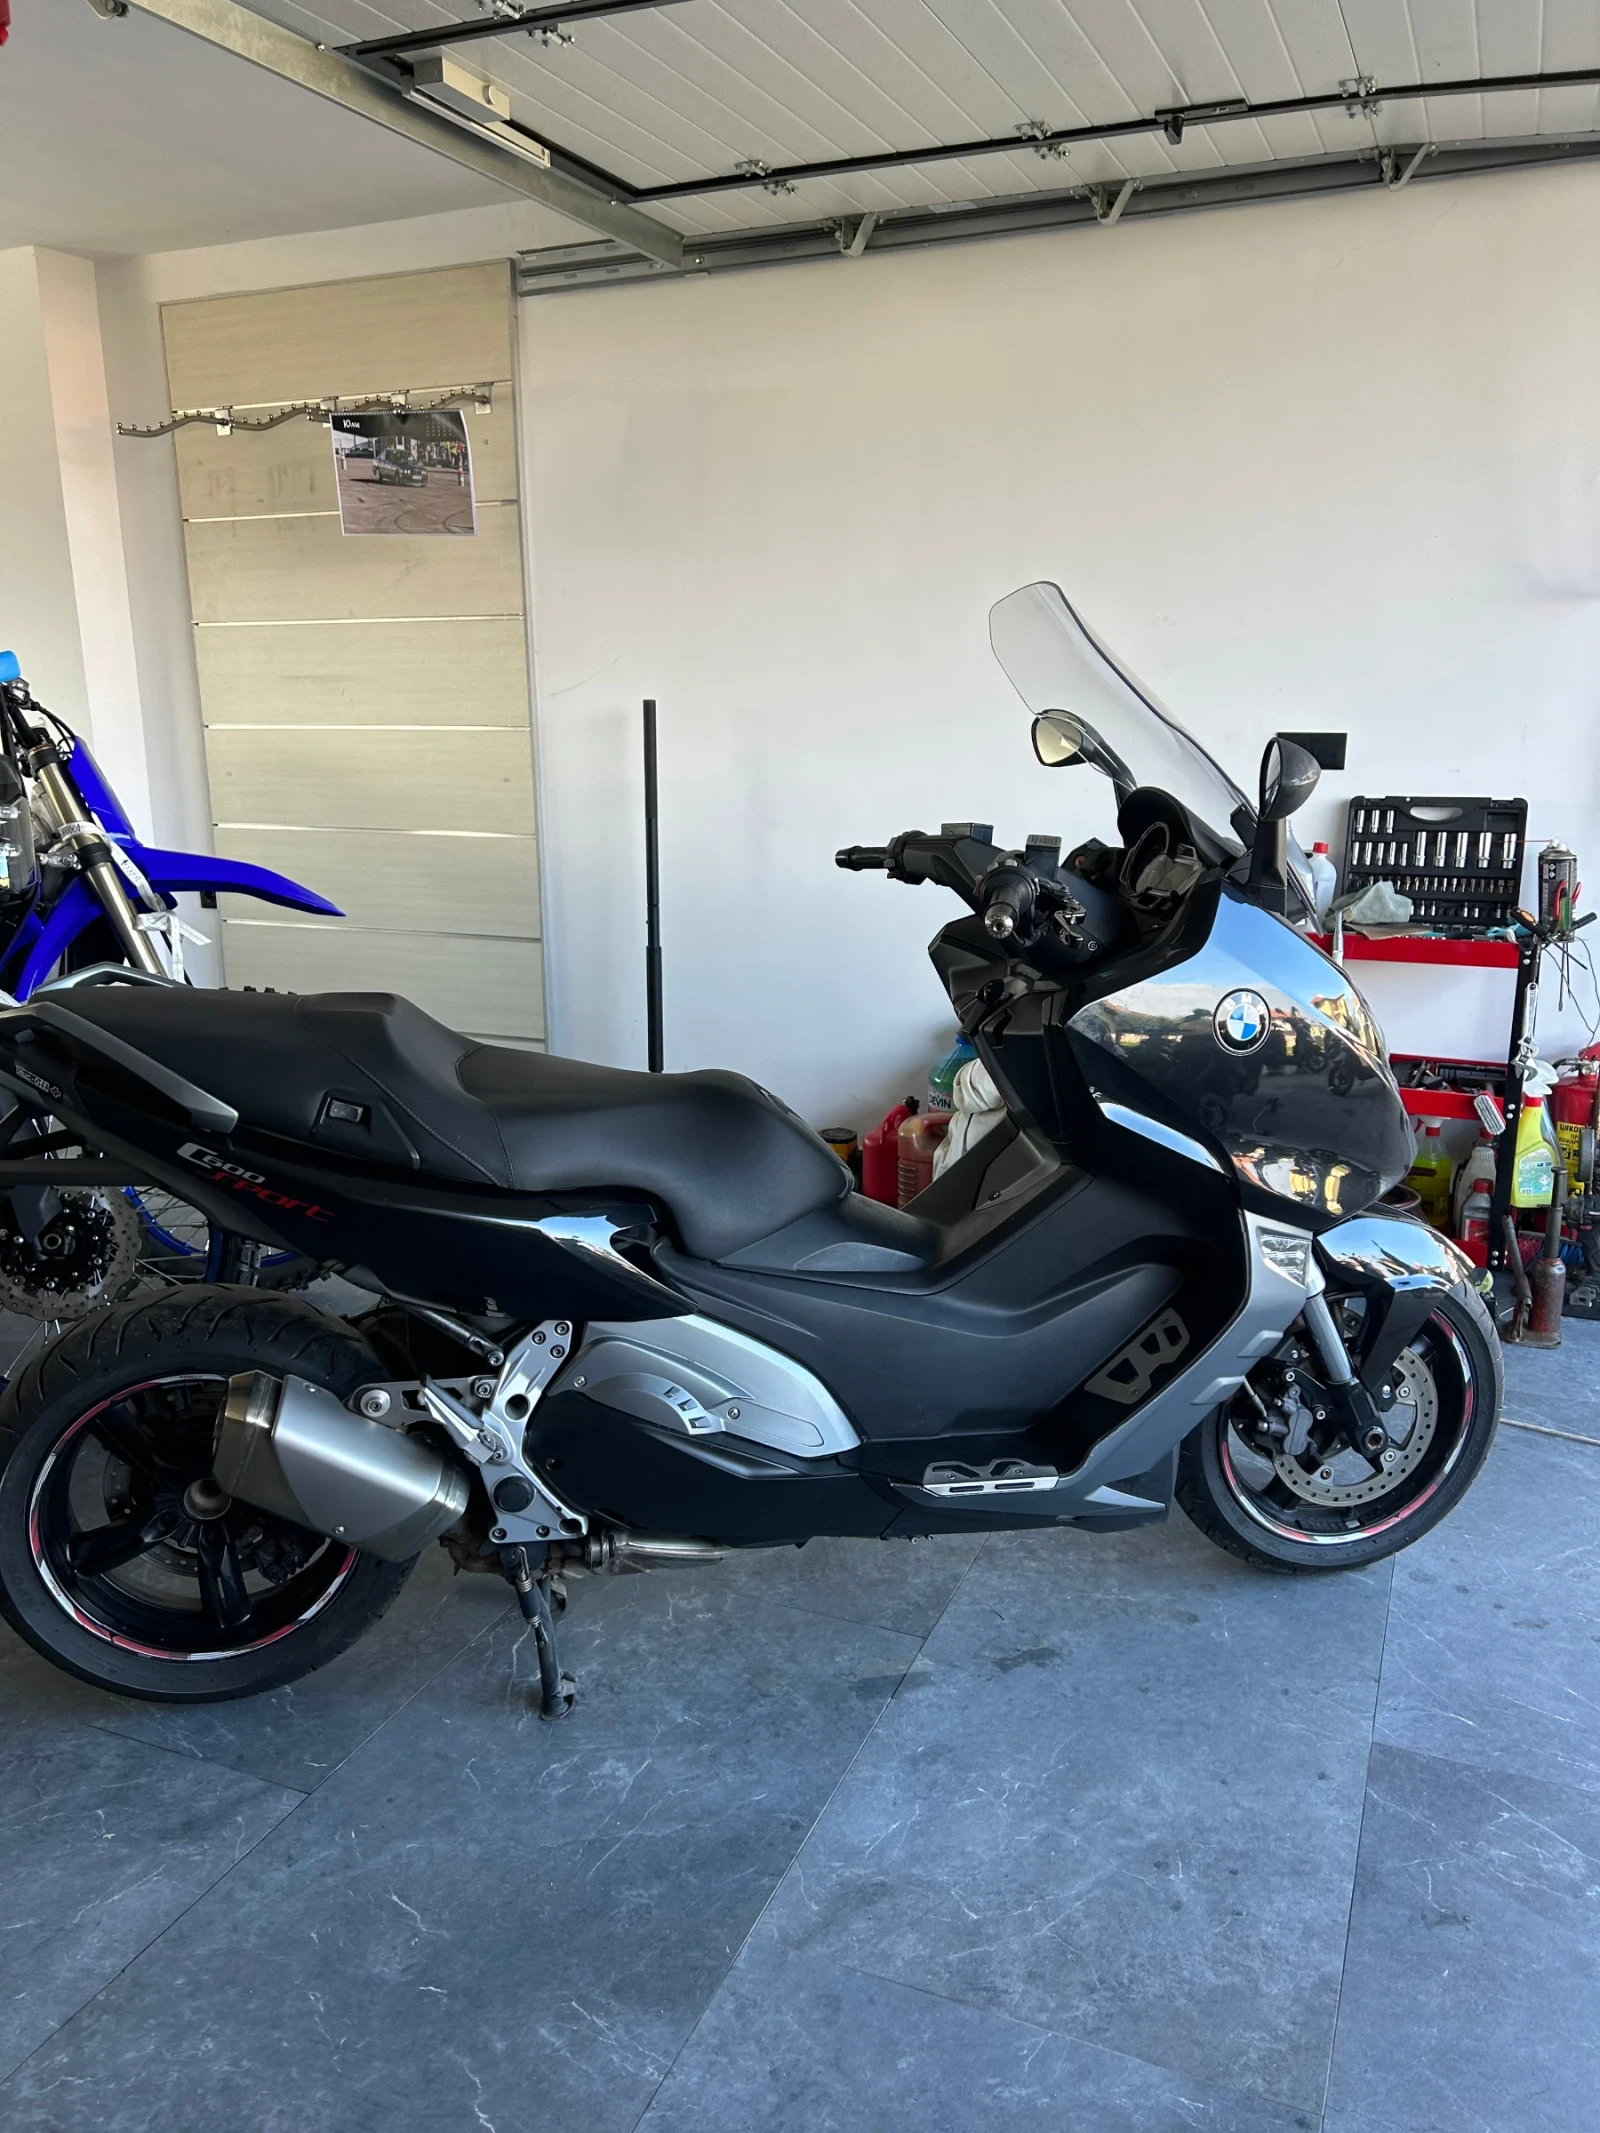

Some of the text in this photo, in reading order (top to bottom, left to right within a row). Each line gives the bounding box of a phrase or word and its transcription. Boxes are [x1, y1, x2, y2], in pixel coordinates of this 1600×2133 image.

[343, 419, 360, 429] Юли
[930, 1096, 951, 1109] DEVIN
[1559, 1123, 1582, 1134] ЦИКО
[177, 1143, 266, 1184] C600
